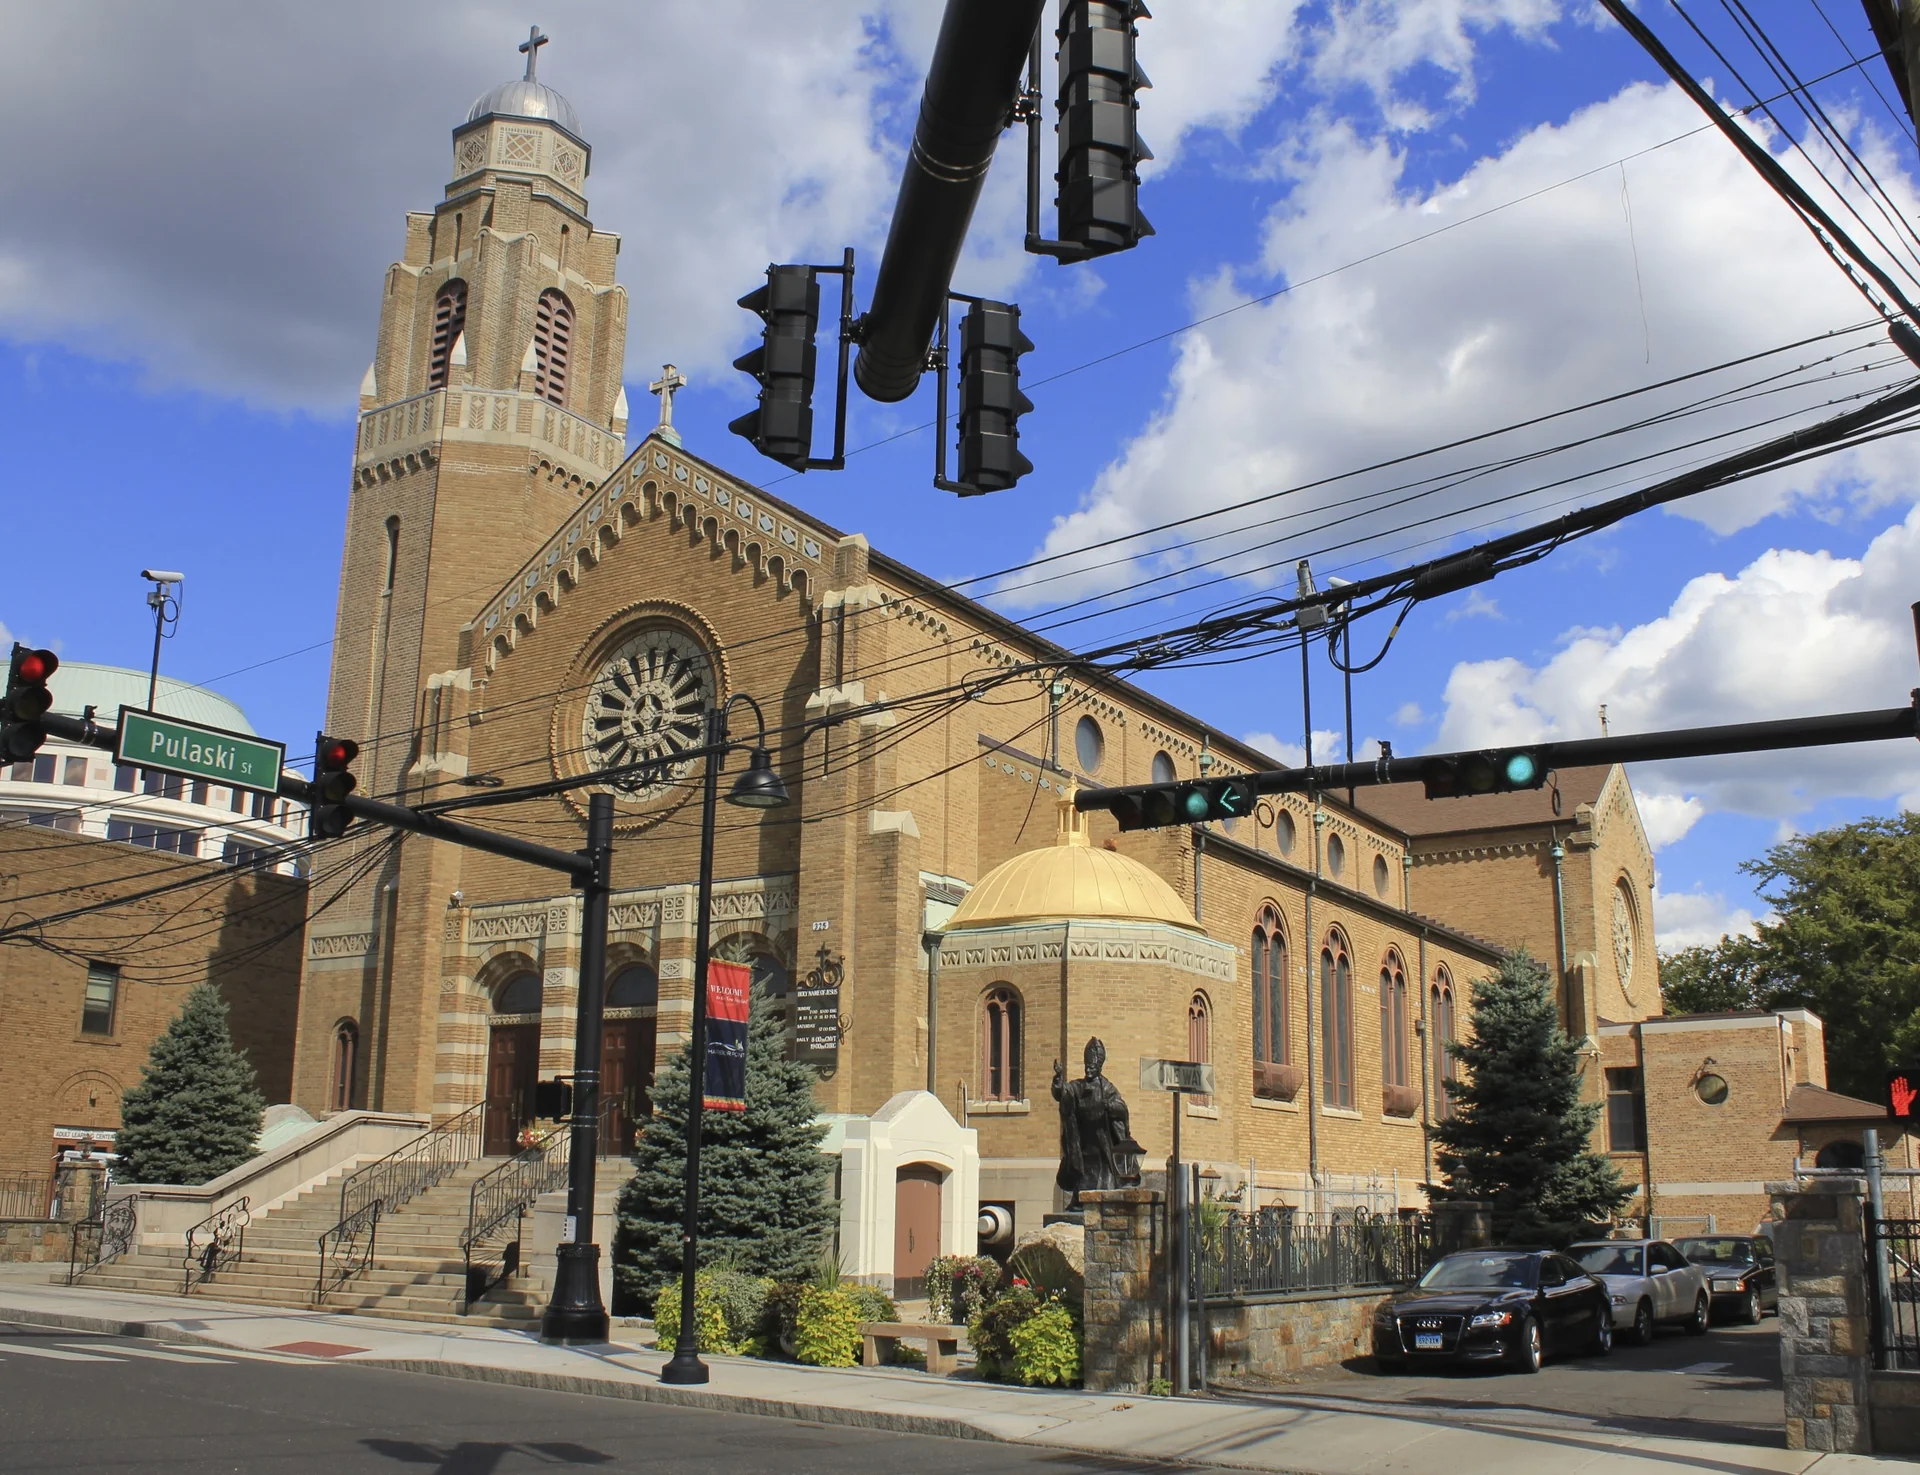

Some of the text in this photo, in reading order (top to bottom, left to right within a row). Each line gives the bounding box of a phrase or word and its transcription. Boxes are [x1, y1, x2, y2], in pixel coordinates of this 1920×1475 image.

[150, 731, 253, 775] Pulaski St
[710, 984, 742, 997] WELCOME
[1158, 1064, 1179, 1083] ONE
